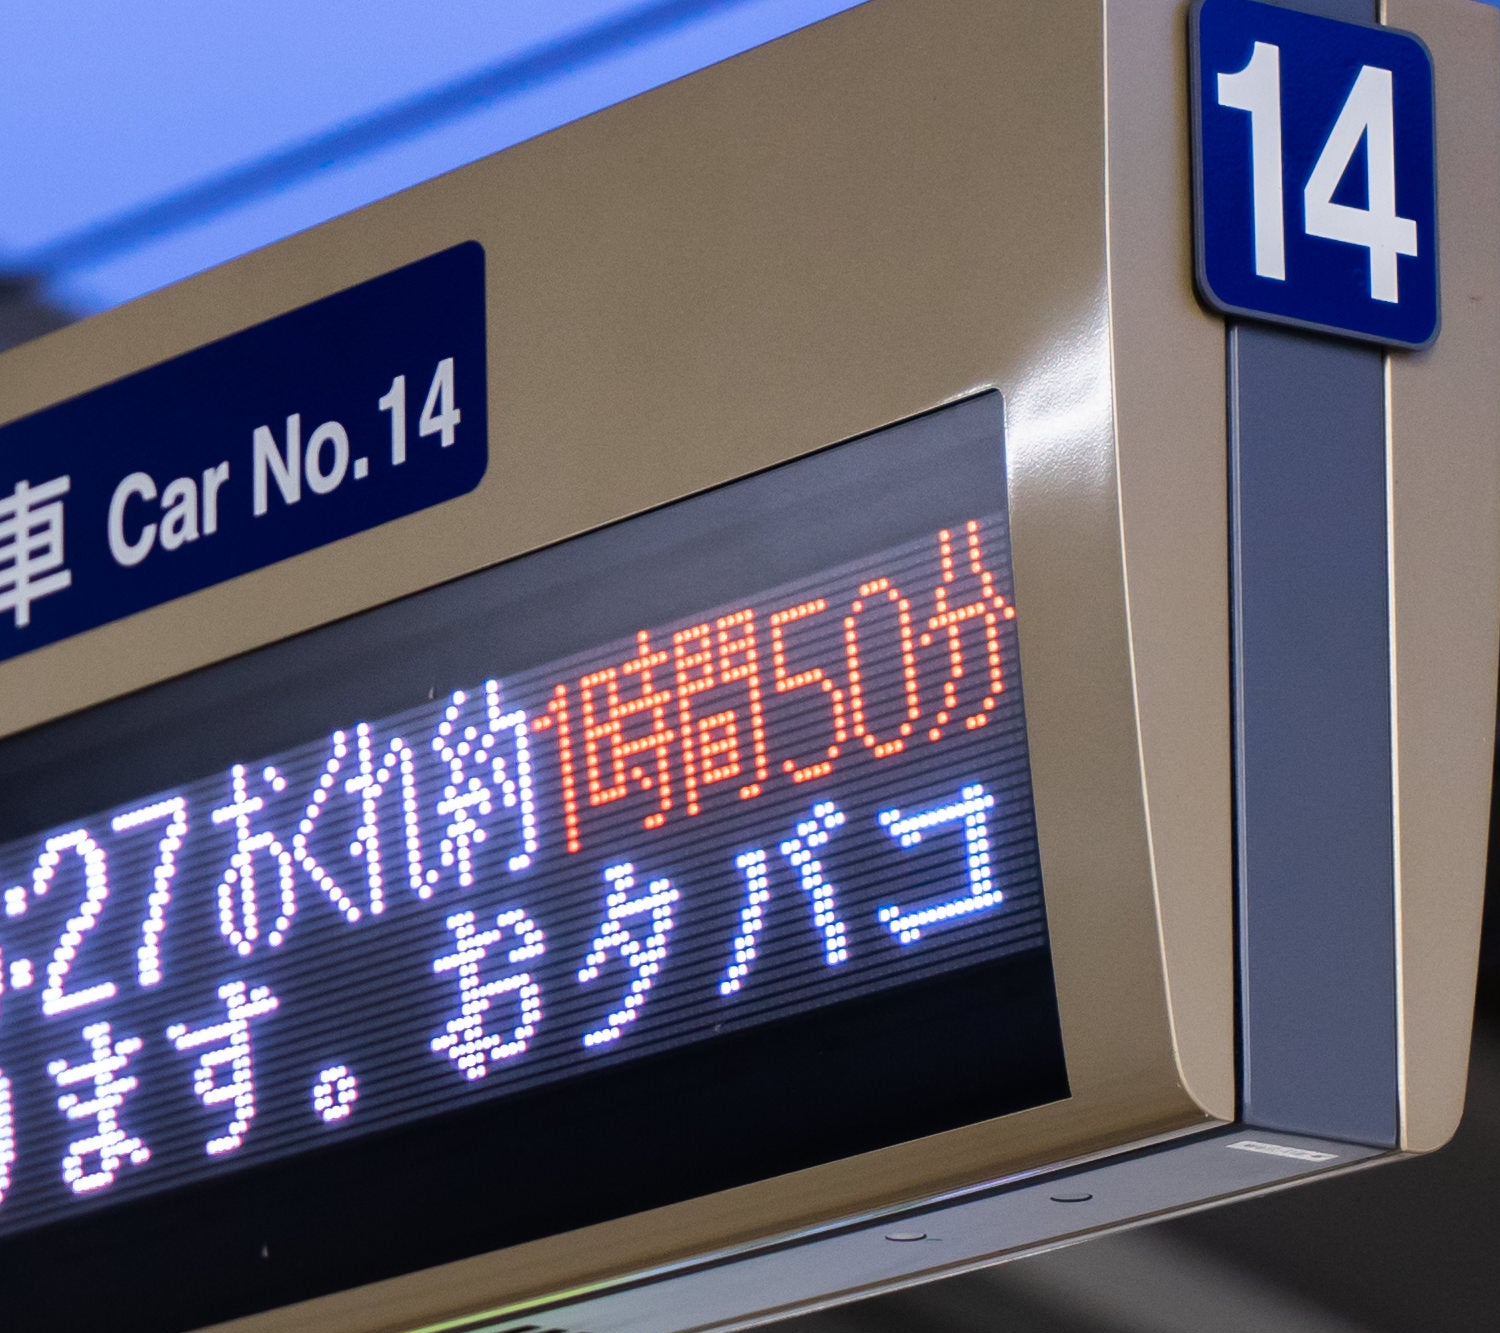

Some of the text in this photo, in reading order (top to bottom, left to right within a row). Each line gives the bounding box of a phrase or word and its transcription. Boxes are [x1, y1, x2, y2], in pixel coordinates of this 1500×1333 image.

[1217, 41, 1418, 304] 14
[107, 458, 230, 567] Car
[251, 357, 462, 517] No.14
